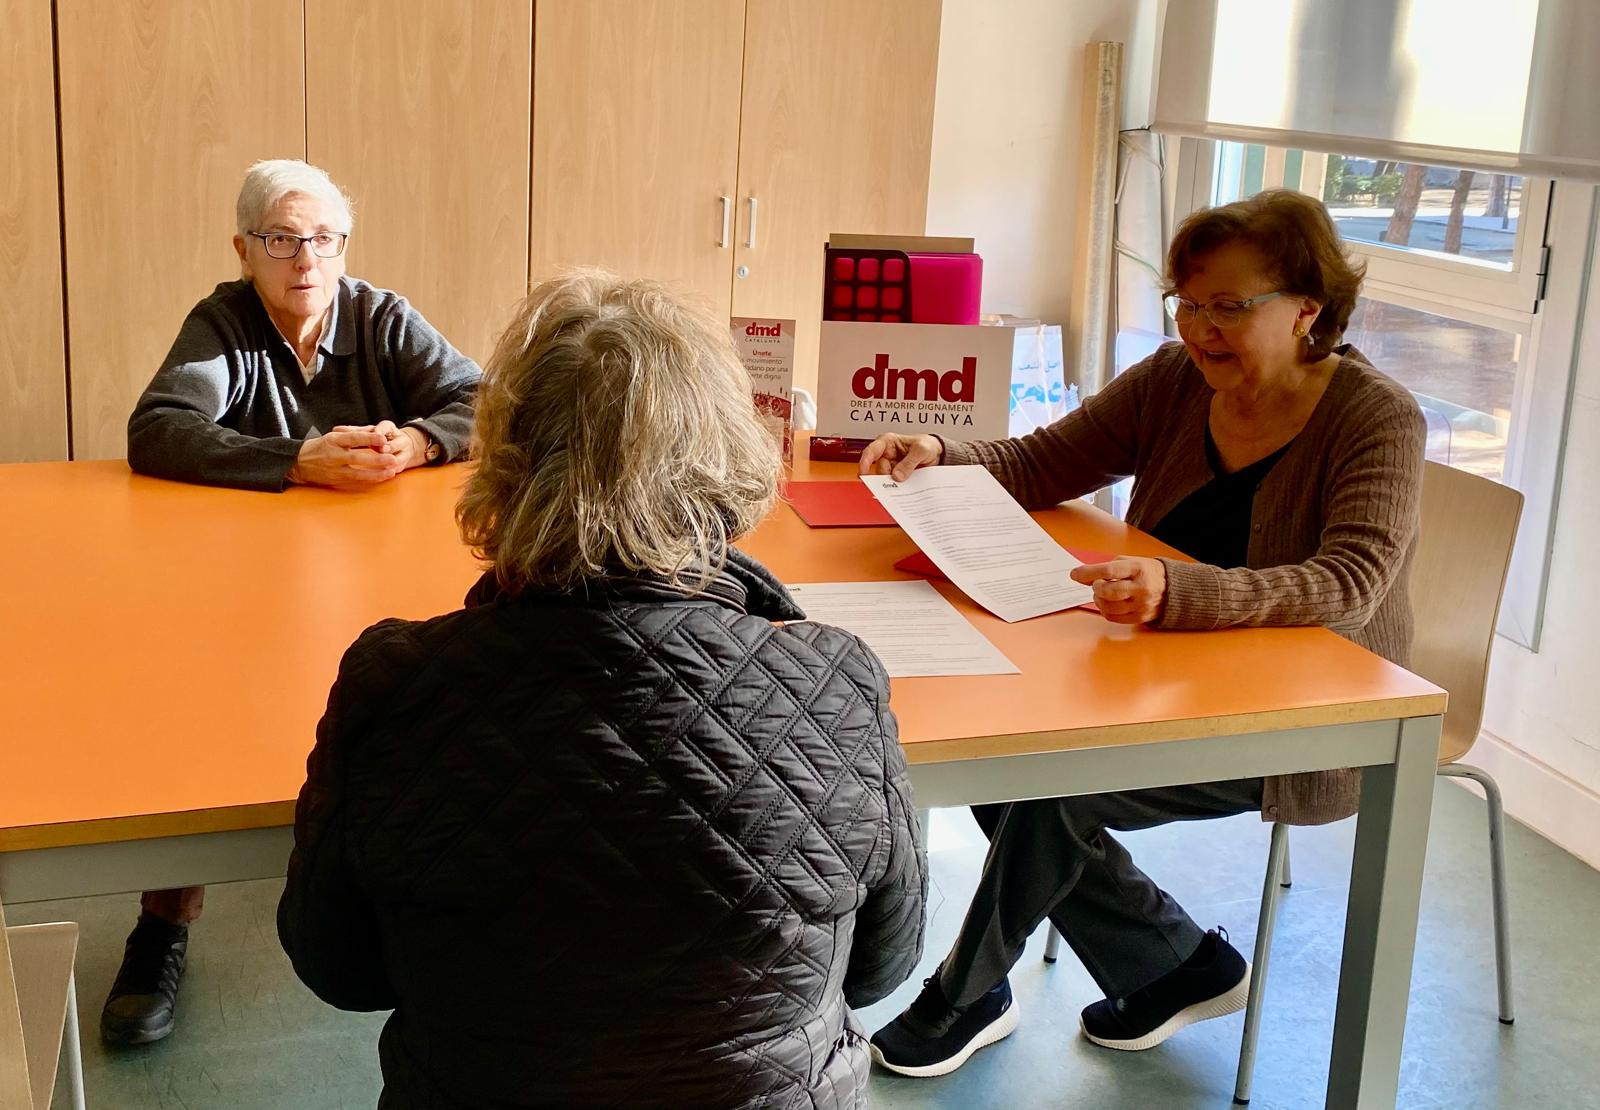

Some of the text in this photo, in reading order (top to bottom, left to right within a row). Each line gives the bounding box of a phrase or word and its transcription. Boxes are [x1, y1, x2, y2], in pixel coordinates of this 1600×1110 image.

[745, 322, 781, 337] dmd
[851, 353, 977, 403] dmd
[850, 400, 975, 412] DRET A MORIR DIGNAMENT
[850, 409, 974, 426] CATALUNYA
